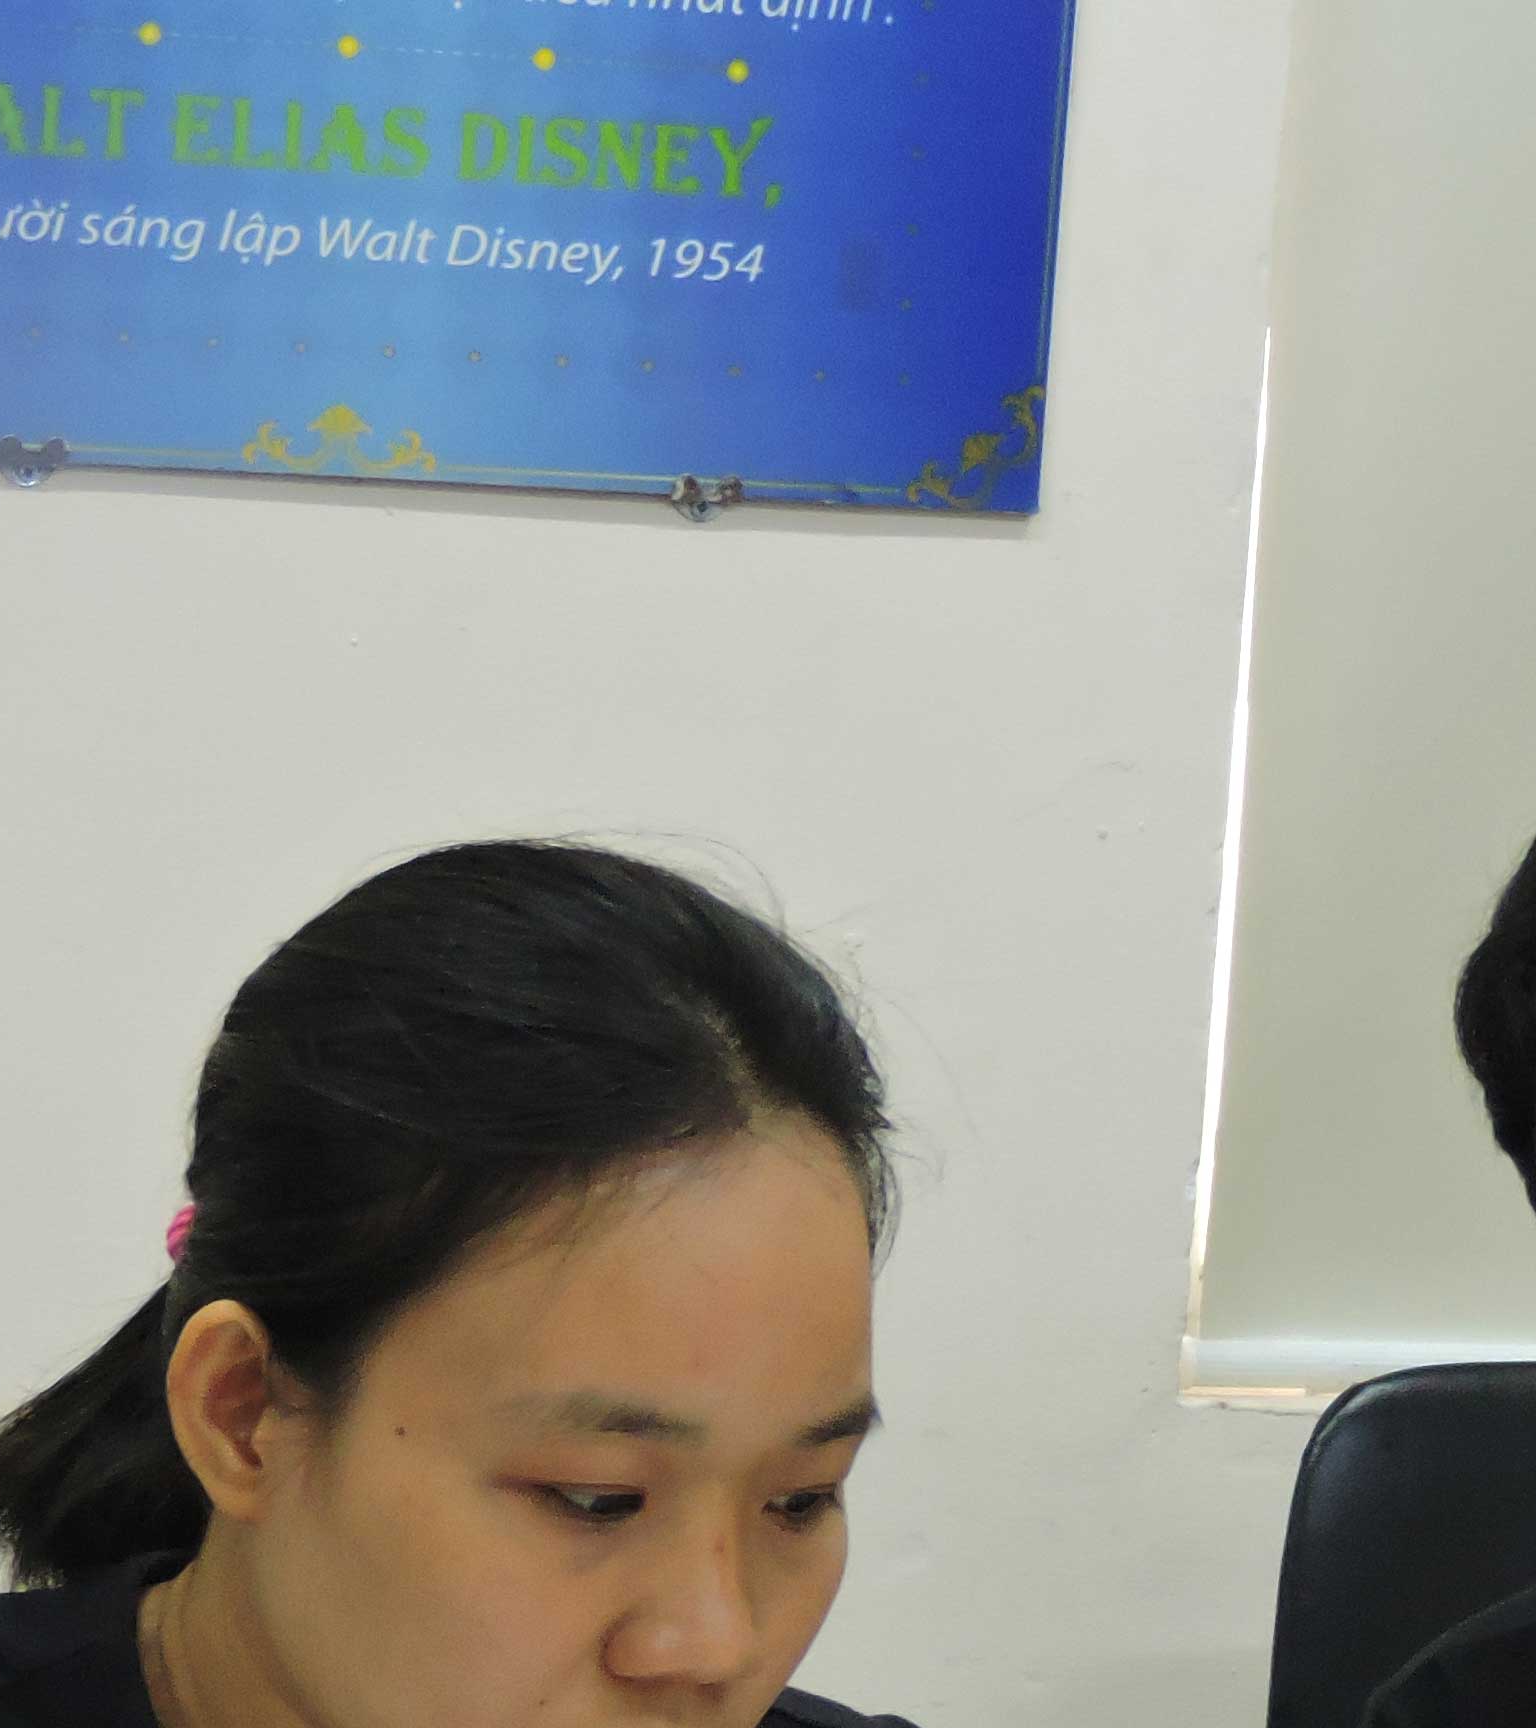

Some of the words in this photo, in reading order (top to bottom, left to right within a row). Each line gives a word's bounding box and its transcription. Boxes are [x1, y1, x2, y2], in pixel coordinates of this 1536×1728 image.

[171, 92, 431, 178] ELIAS
[456, 112, 782, 208] DISNEY,
[79, 204, 206, 262] sáng
[218, 208, 301, 267] lập
[318, 216, 438, 264] Walt
[446, 224, 625, 285] Disney,
[648, 238, 766, 282] 1954
